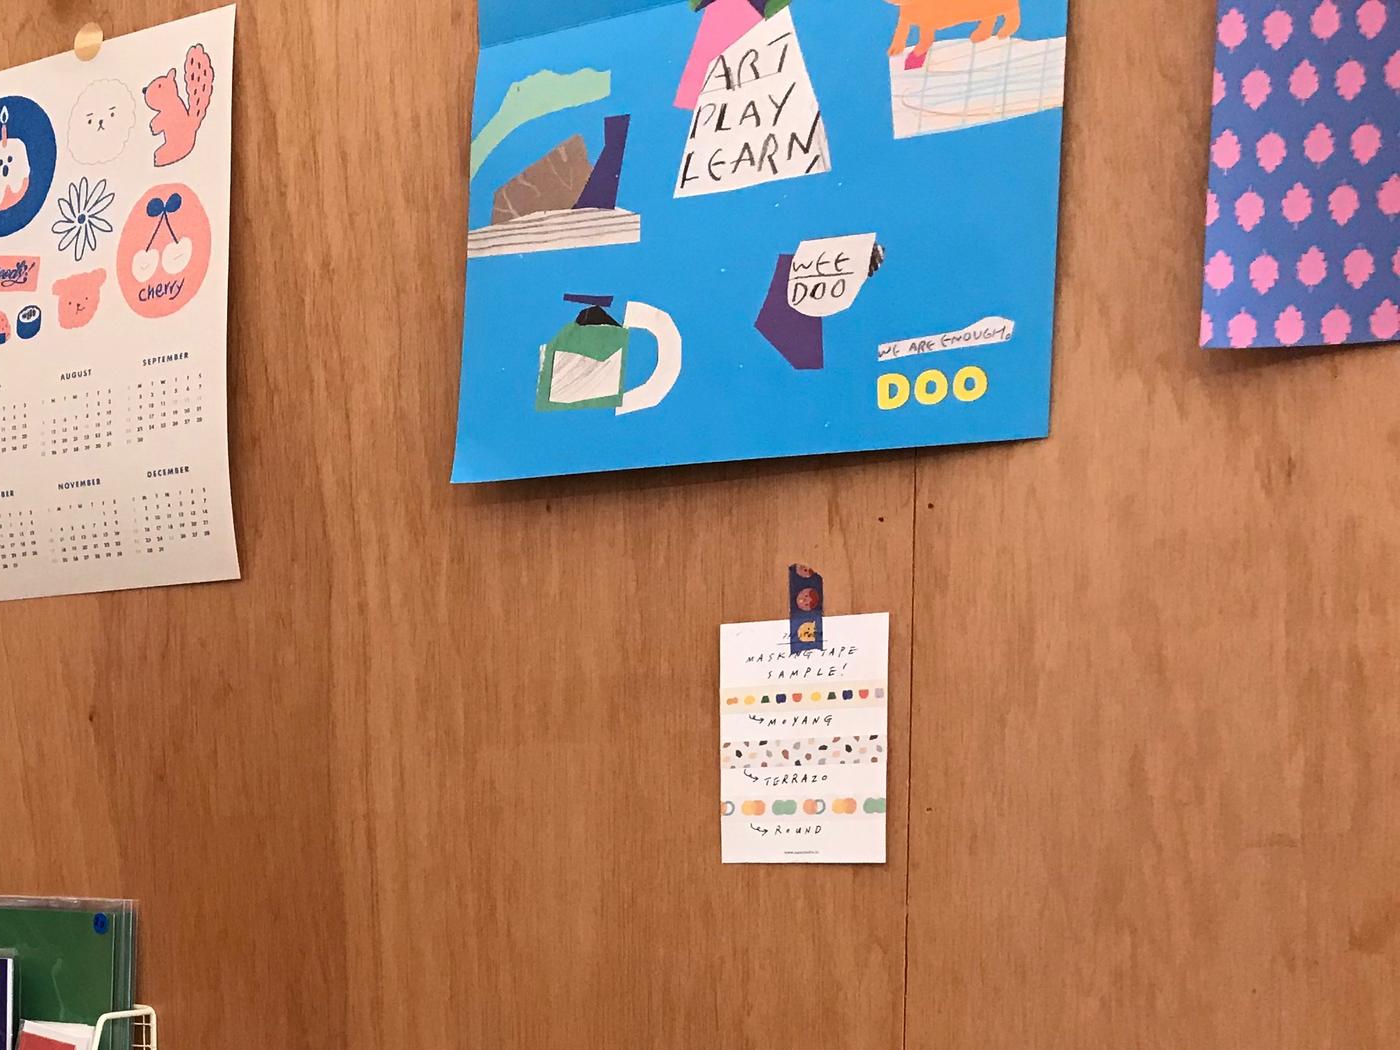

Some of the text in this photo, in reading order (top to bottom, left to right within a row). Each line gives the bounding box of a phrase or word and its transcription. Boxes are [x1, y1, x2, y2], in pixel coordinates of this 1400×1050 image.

[701, 32, 791, 92] ART
[690, 82, 796, 139] PLAY
[680, 110, 821, 189] LEARN
[792, 251, 850, 275] WEE
[138, 278, 185, 302] cherry
[792, 278, 846, 306] DOO
[142, 352, 190, 367] SEPTEMBER
[878, 344, 900, 358] WE
[908, 340, 935, 354] ARE
[60, 368, 92, 381] AUGUST
[876, 365, 988, 411] DOO
[146, 465, 190, 478] DECEMBER
[57, 478, 101, 490] NOVEMBER
[767, 662, 848, 680] SAMPLE!
